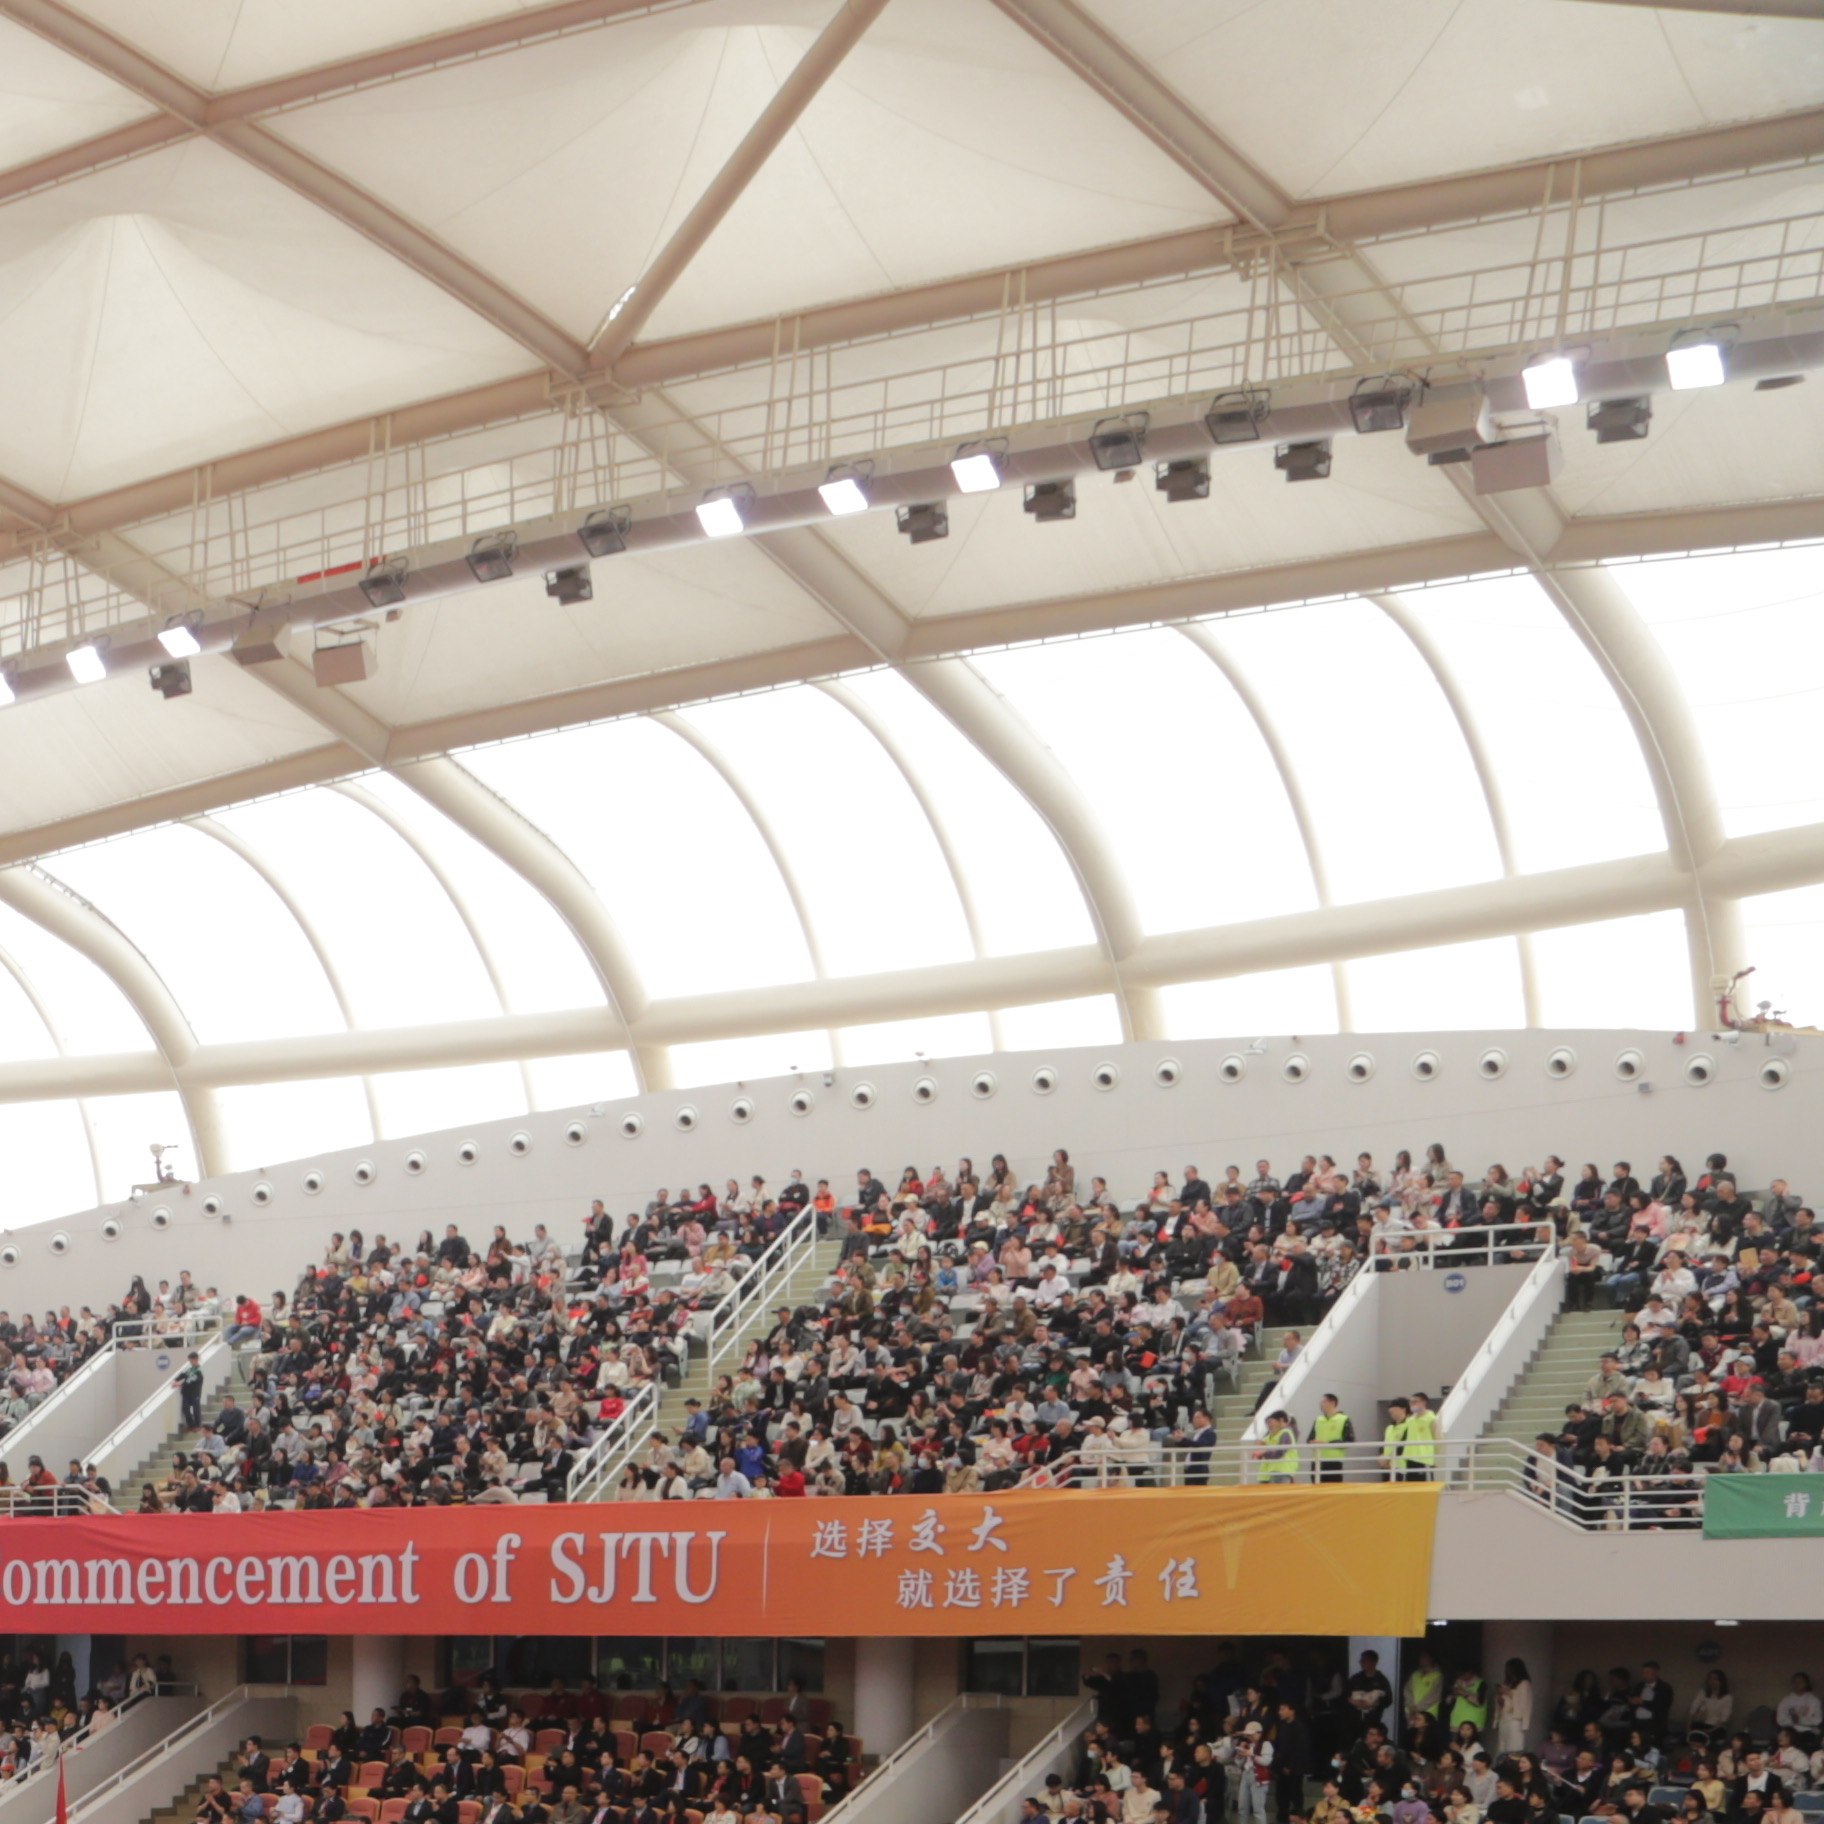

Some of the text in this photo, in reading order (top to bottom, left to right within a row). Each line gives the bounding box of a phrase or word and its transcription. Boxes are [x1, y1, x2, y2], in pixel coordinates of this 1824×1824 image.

[809, 1506, 1007, 1560] 选择交大
[453, 1531, 515, 1604] of
[549, 1530, 726, 1606] SJTU
[894, 1552, 1201, 1611] 就选择了责任
